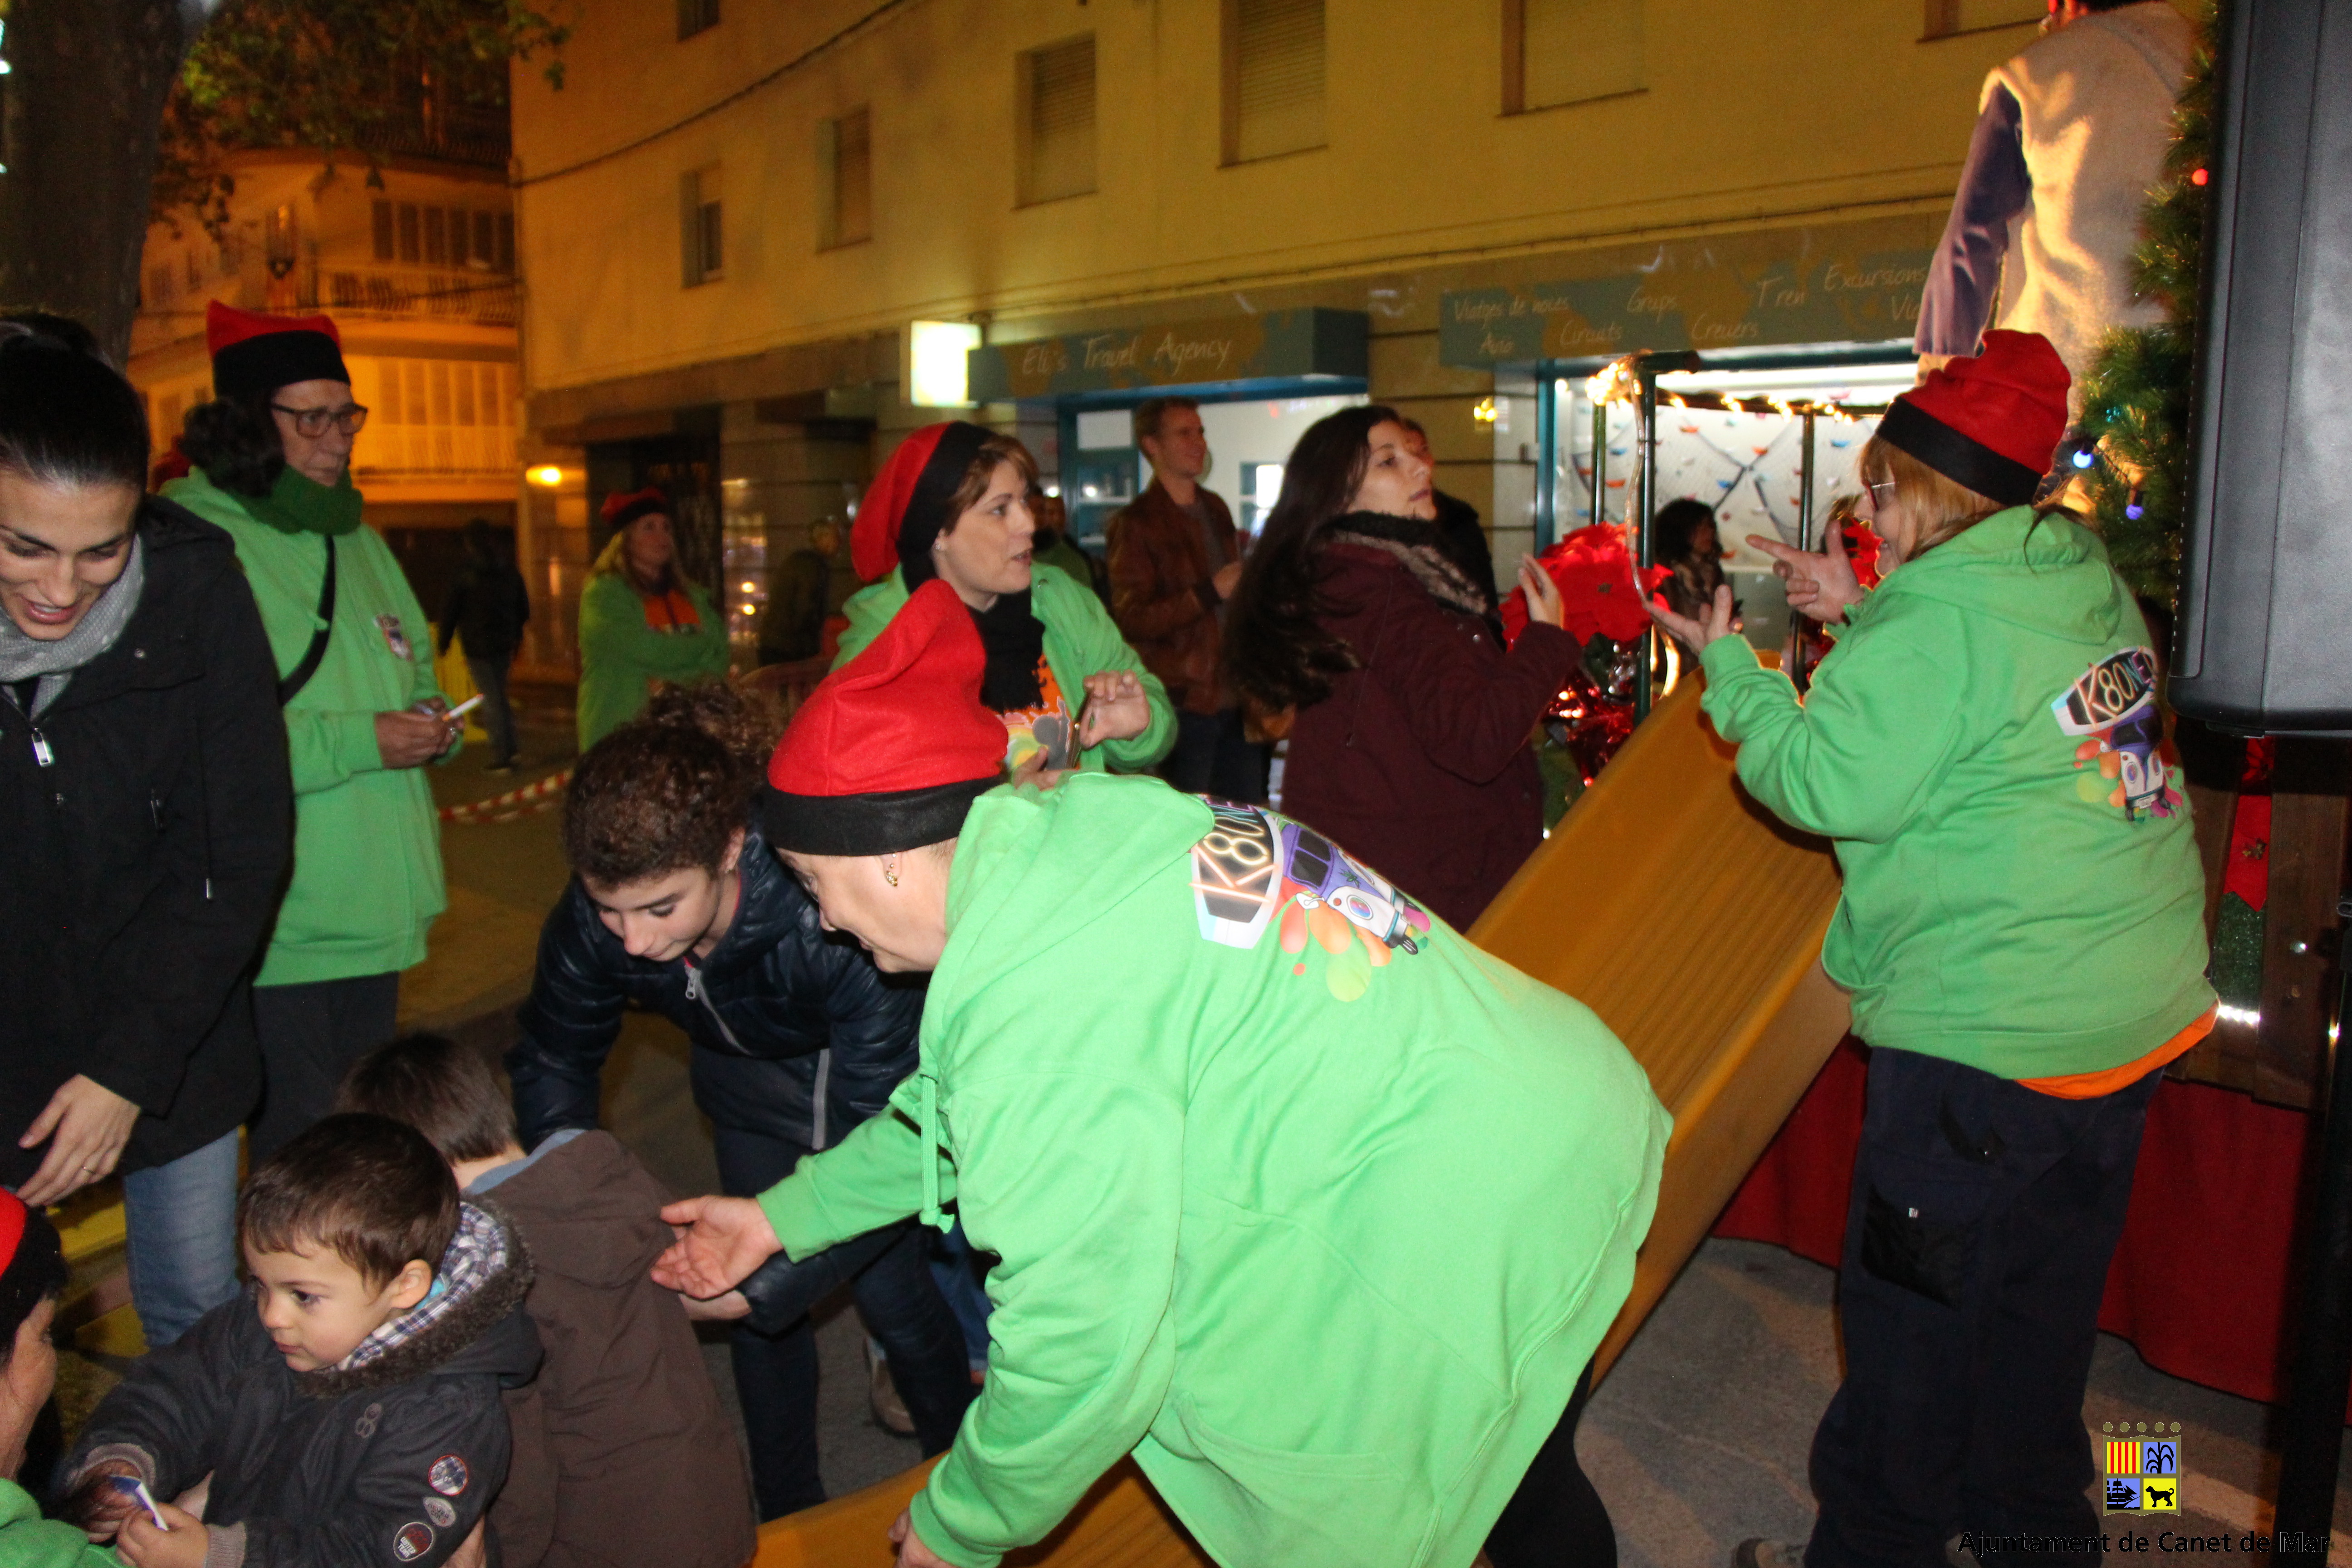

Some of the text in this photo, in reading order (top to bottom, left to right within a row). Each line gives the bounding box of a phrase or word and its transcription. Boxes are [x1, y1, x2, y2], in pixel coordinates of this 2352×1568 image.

[1824, 262, 1928, 292] Excursions
[1022, 331, 1232, 377] Eli's Travel Agency
